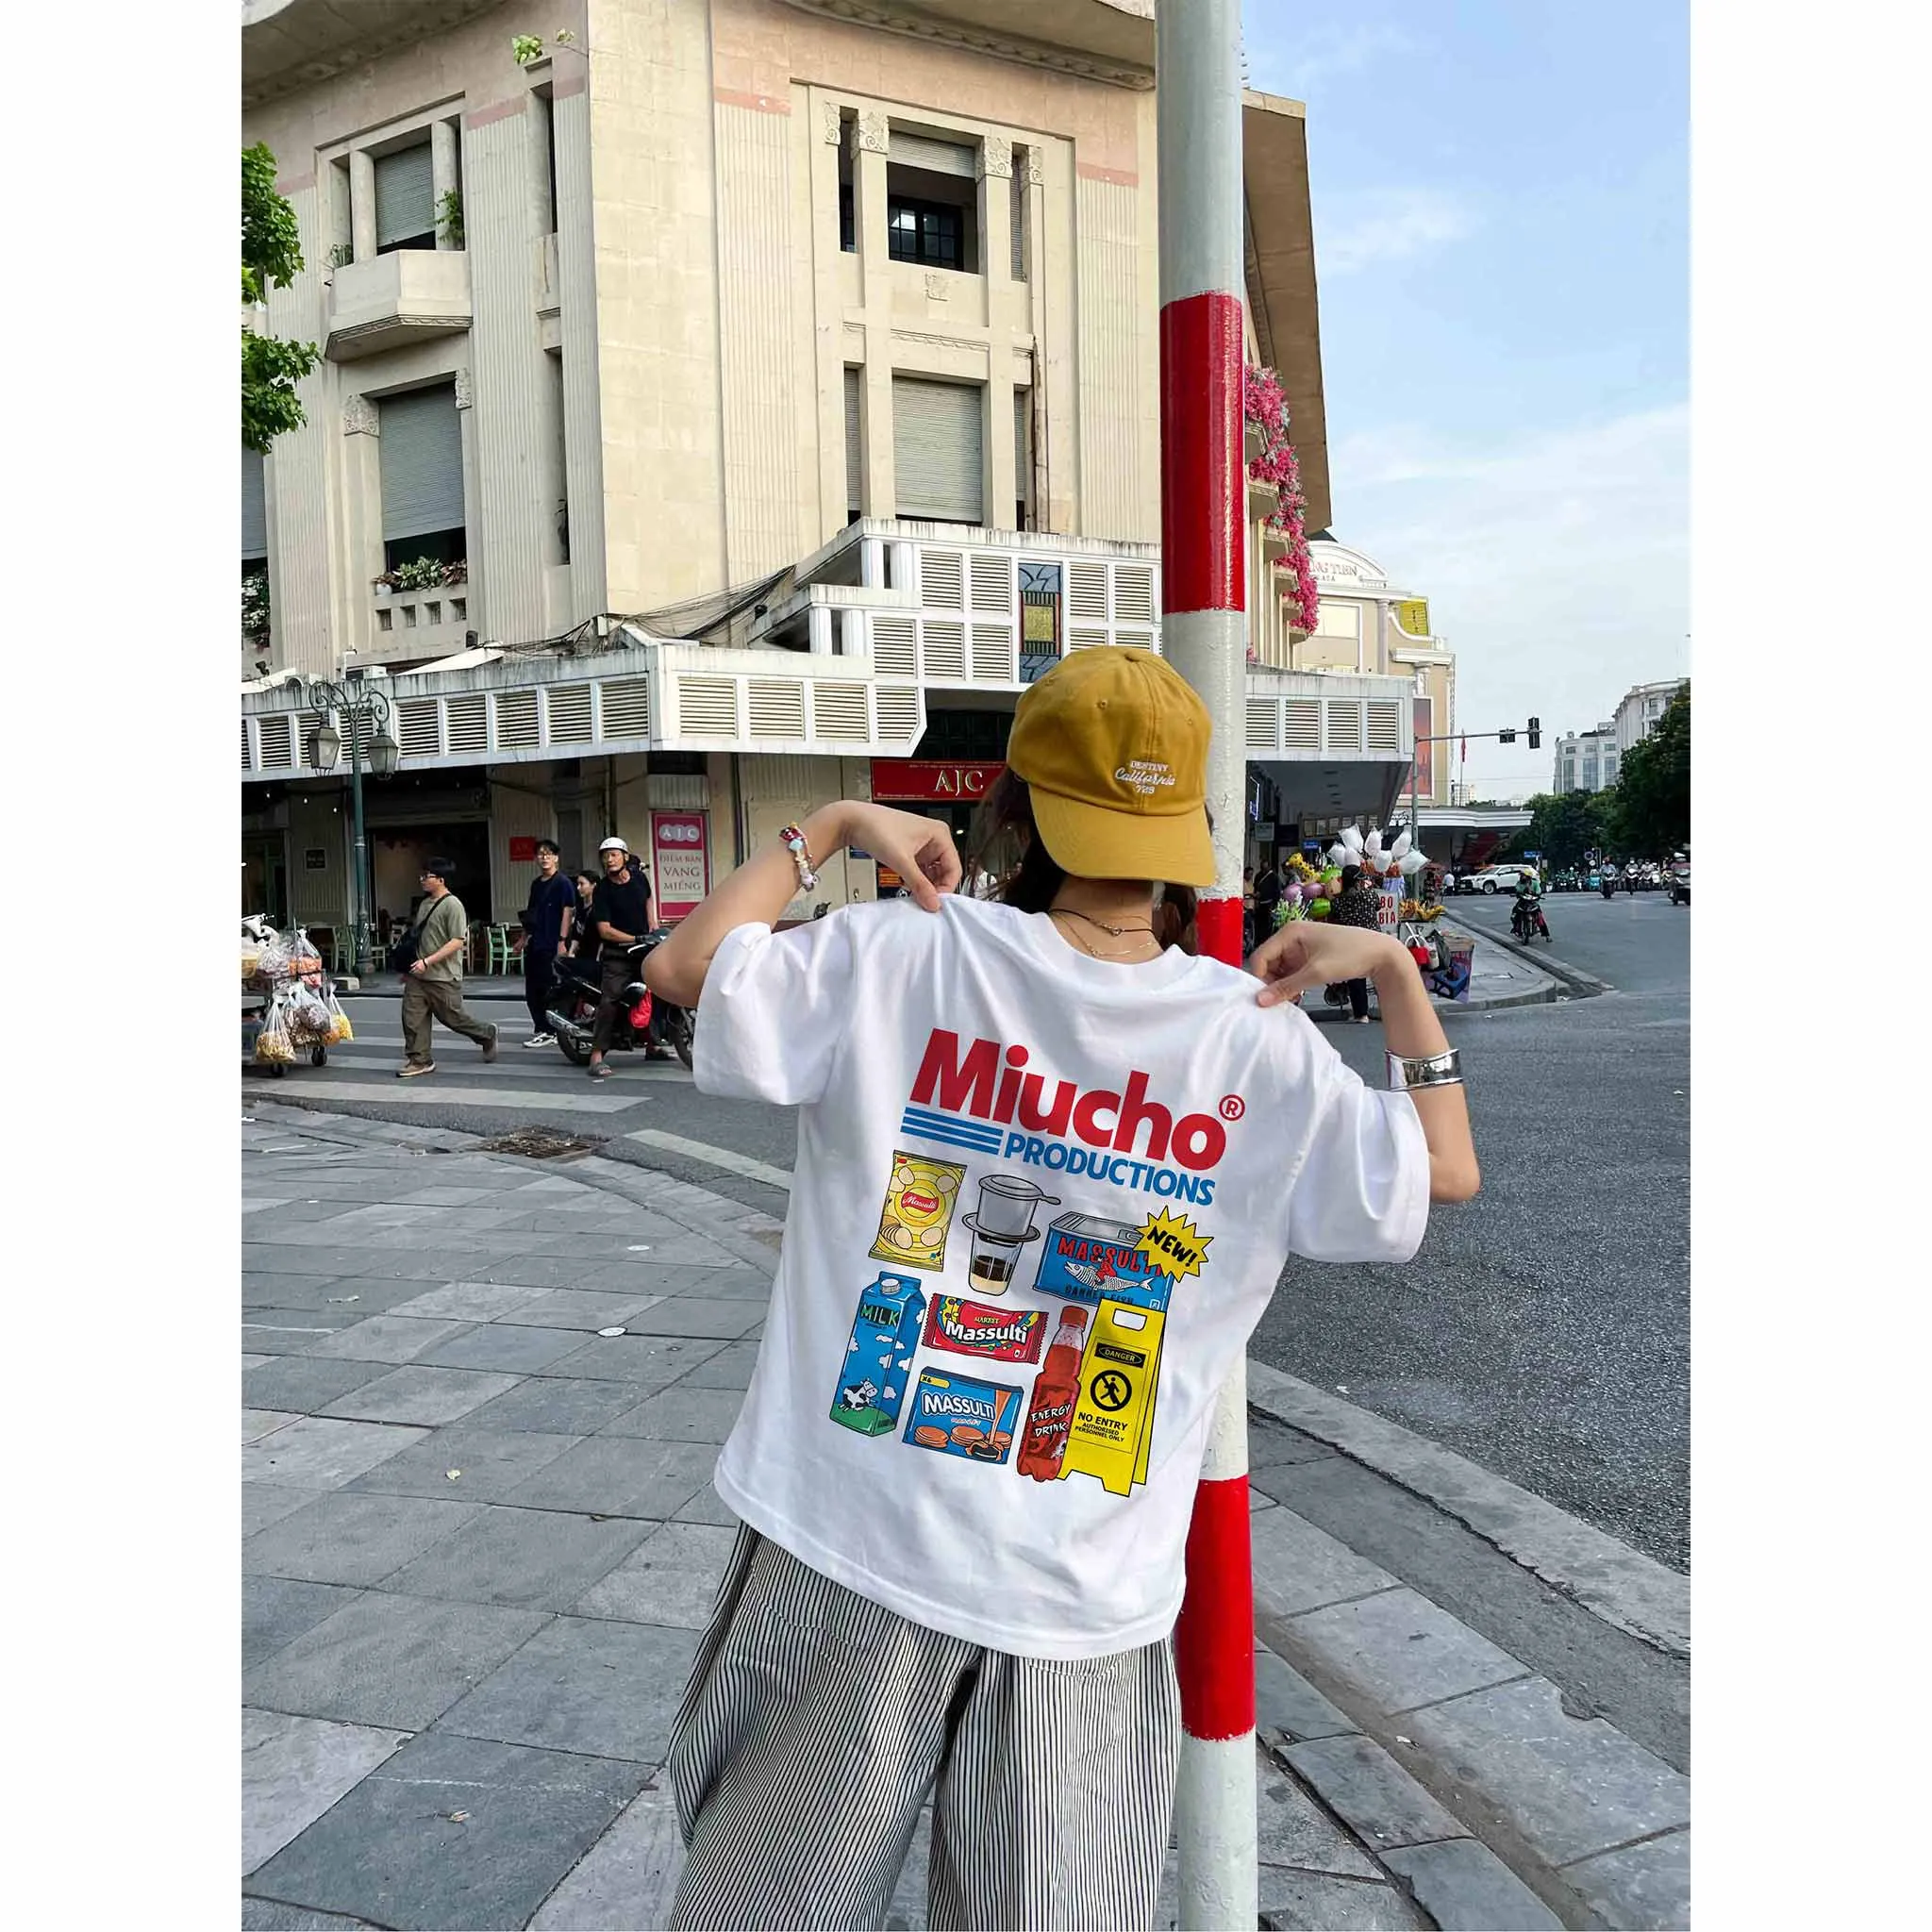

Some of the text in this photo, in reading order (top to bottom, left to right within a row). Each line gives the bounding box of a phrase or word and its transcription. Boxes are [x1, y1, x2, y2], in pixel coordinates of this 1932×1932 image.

[933, 769, 984, 797] AJC
[909, 1027, 1227, 1171] Miucho
[1004, 1132, 1216, 1207] PRODUCTIONS
[1146, 1225, 1199, 1267] NEW!
[860, 1304, 899, 1327] MILK
[945, 1320, 1028, 1344] Massulti
[1105, 1349, 1135, 1362] DANGER
[924, 1393, 996, 1420] MASSULTI
[1031, 1404, 1072, 1423] ENERGY
[1034, 1422, 1068, 1438] DRINK
[1077, 1412, 1128, 1431] NO ENTRY
[1082, 1423, 1120, 1436] AUTHORISED
[1074, 1425, 1124, 1442] PERSONNEL ONLY
